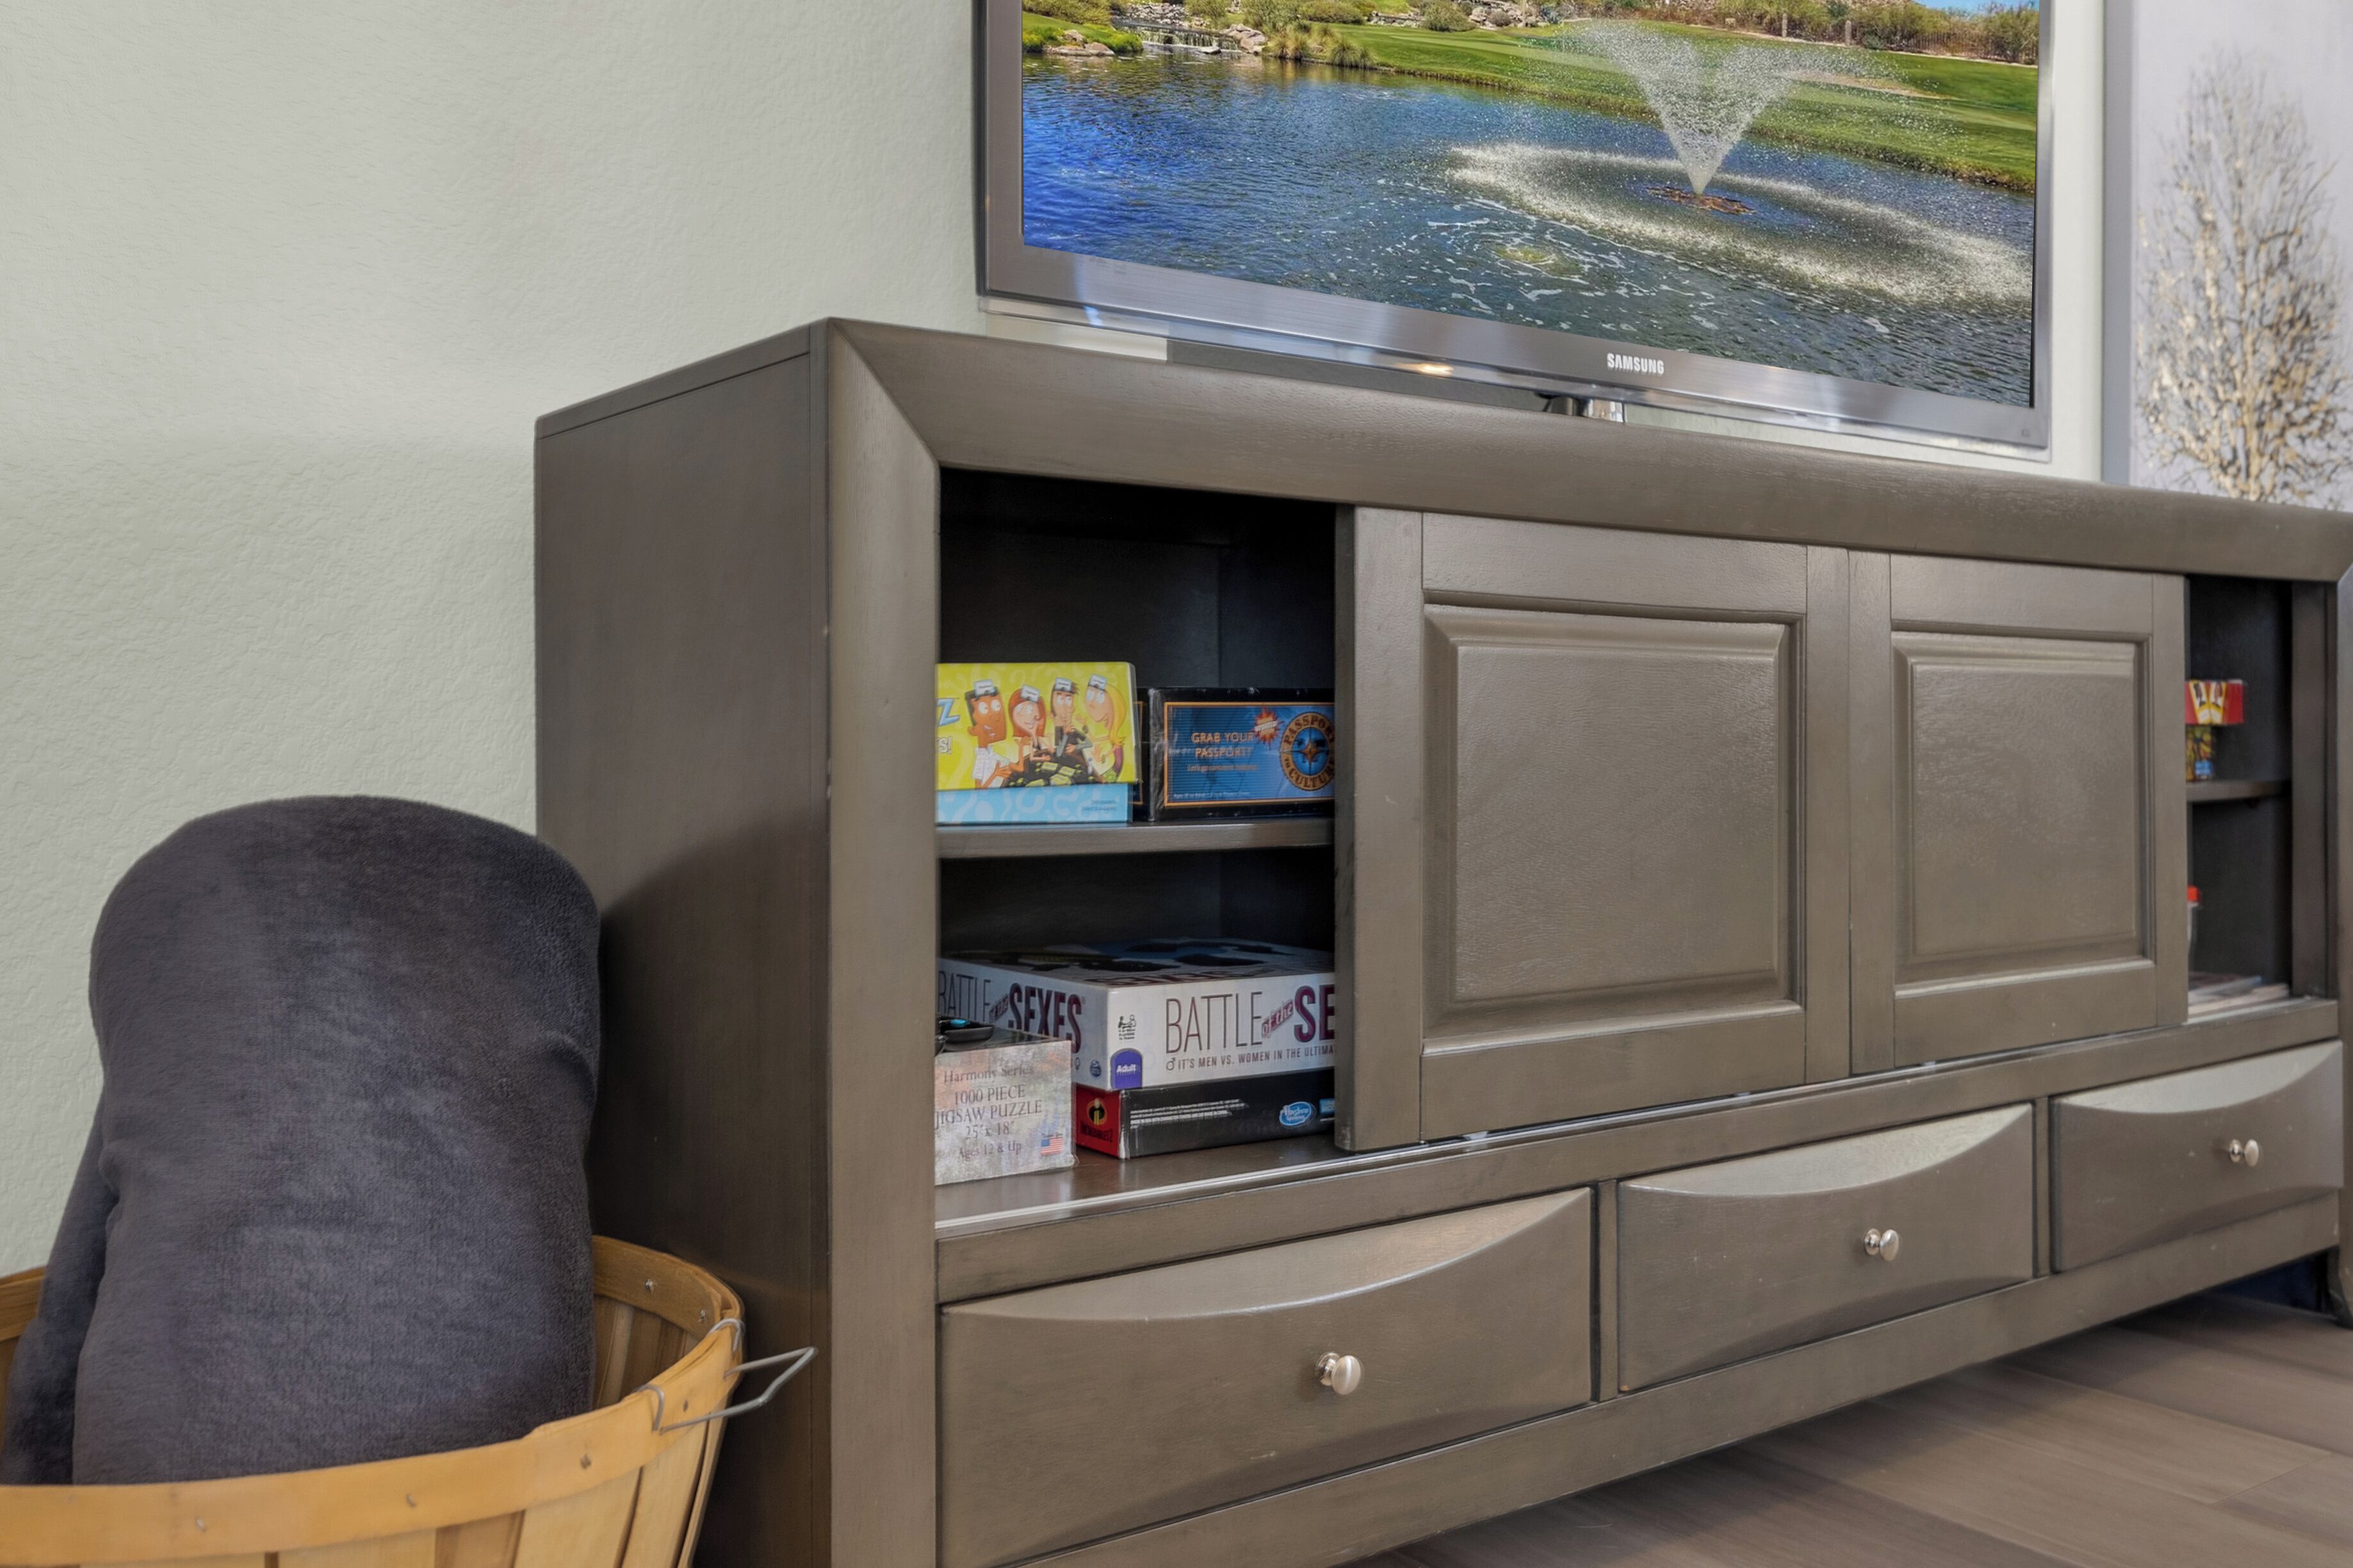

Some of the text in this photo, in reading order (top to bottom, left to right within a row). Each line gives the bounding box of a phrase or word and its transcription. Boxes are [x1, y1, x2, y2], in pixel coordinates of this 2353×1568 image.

[1607, 353, 1664, 375] SAMSUNG
[1191, 731, 1254, 743] GRAB YOUR
[1166, 991, 1263, 1054] BATTLE
[1274, 1000, 1293, 1025] the
[1116, 1063, 1137, 1073] Adult
[1178, 1058, 1194, 1070] IT'S
[1198, 1056, 1217, 1068] MEN
[1221, 1055, 1235, 1065] VS.
[1238, 1051, 1270, 1063] WOMEN
[1273, 1049, 1283, 1060] IN
[1286, 1047, 1301, 1058] THE
[943, 1065, 1035, 1084] Harmony Series
[954, 1084, 1025, 1106] 1000 PIECE
[936, 1099, 1043, 1130] JIGSAW PUZZLE
[1008, 1140, 1022, 1156] Up
